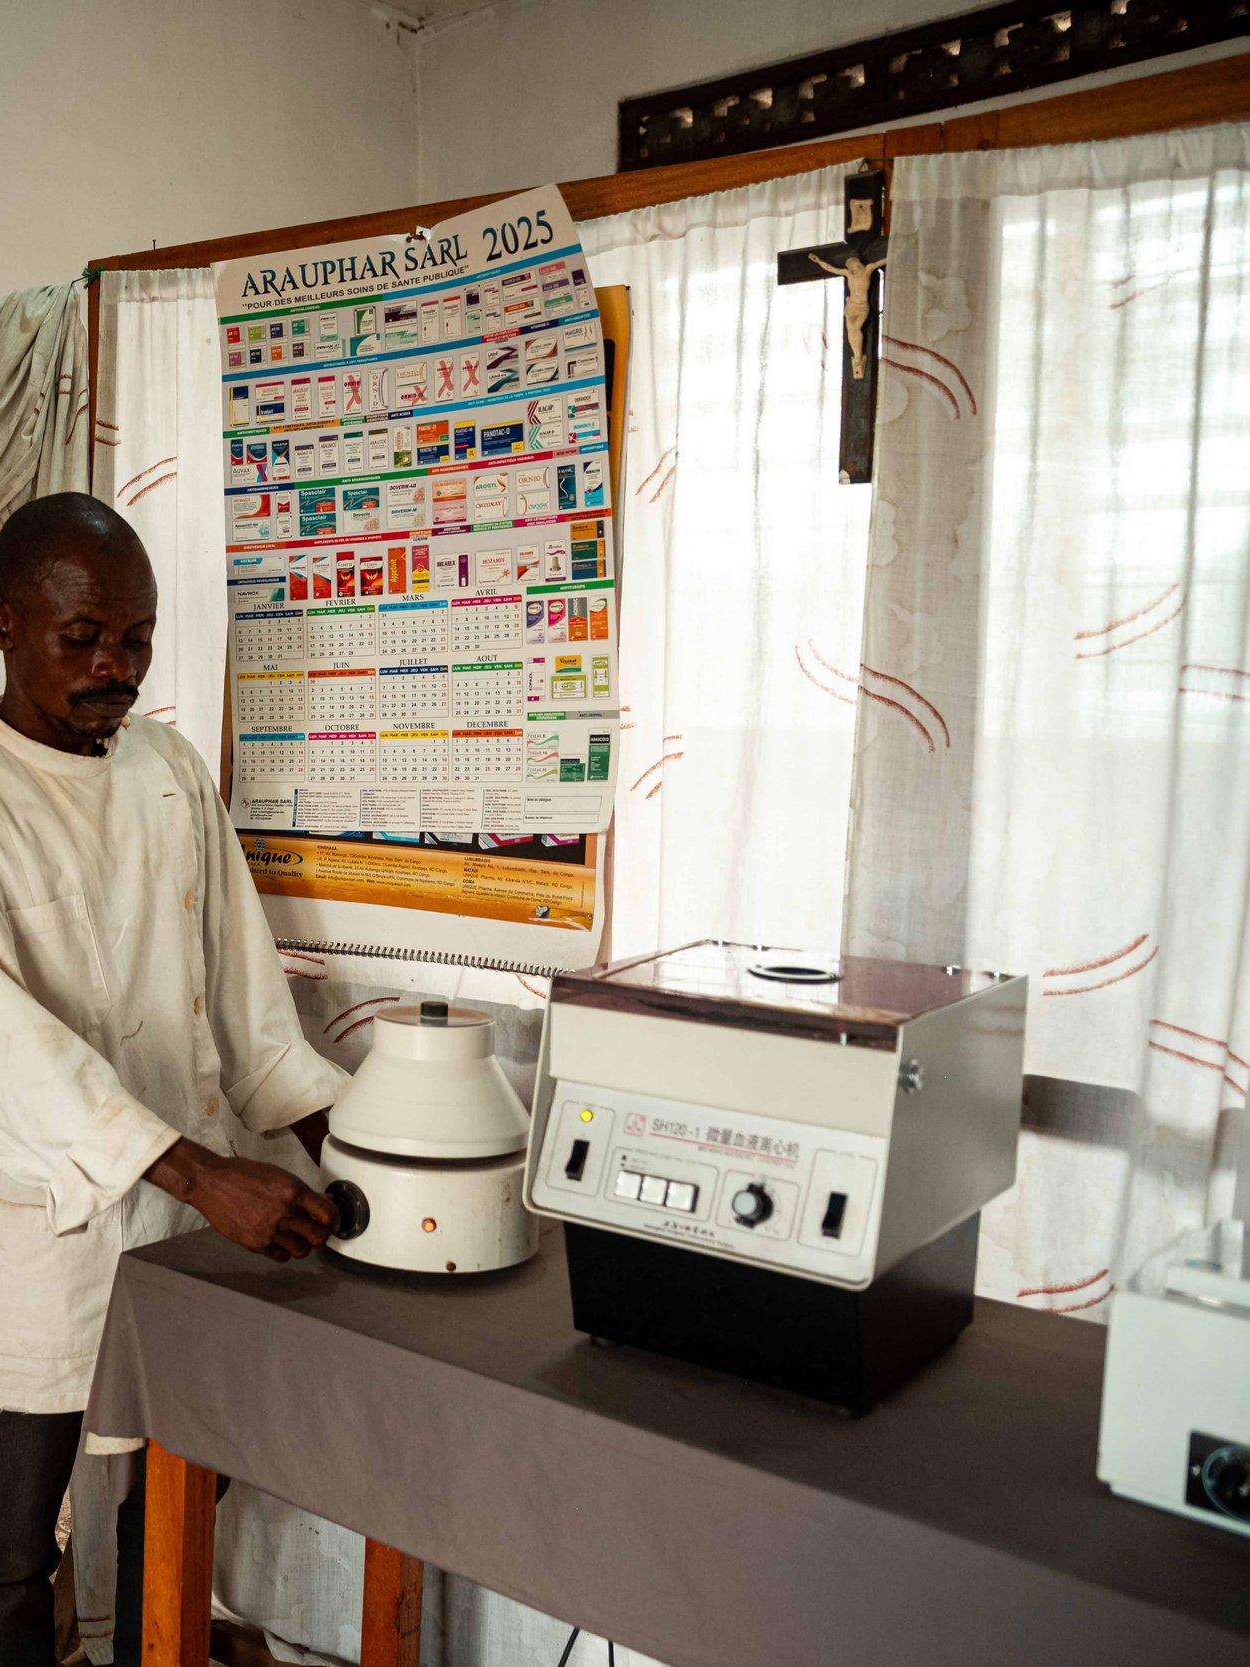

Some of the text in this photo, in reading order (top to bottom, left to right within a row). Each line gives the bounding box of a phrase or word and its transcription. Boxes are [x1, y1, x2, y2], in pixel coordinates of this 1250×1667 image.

[241, 209, 554, 297] ARAUPHAR SARL 2025
[275, 298, 292, 306] DES
[294, 290, 345, 303] MEILLEURS
[347, 285, 374, 296] SOINS
[377, 282, 389, 291] DE
[391, 276, 421, 288] SANTE
[300, 488, 327, 497] Spasclair
[301, 514, 327, 522] Spasclair
[475, 588, 498, 596] AVRIL
[402, 594, 424, 602] MARS
[253, 602, 285, 611] JANVIER
[325, 599, 356, 607] FEVRIER
[333, 661, 350, 669] JUIN
[399, 658, 428, 666] JUILLET
[251, 725, 293, 733] SEPTEMBRE
[324, 723, 360, 731] OCTOBRE
[392, 722, 436, 730] NOVEMBRE
[466, 721, 508, 729] DECEMBRE
